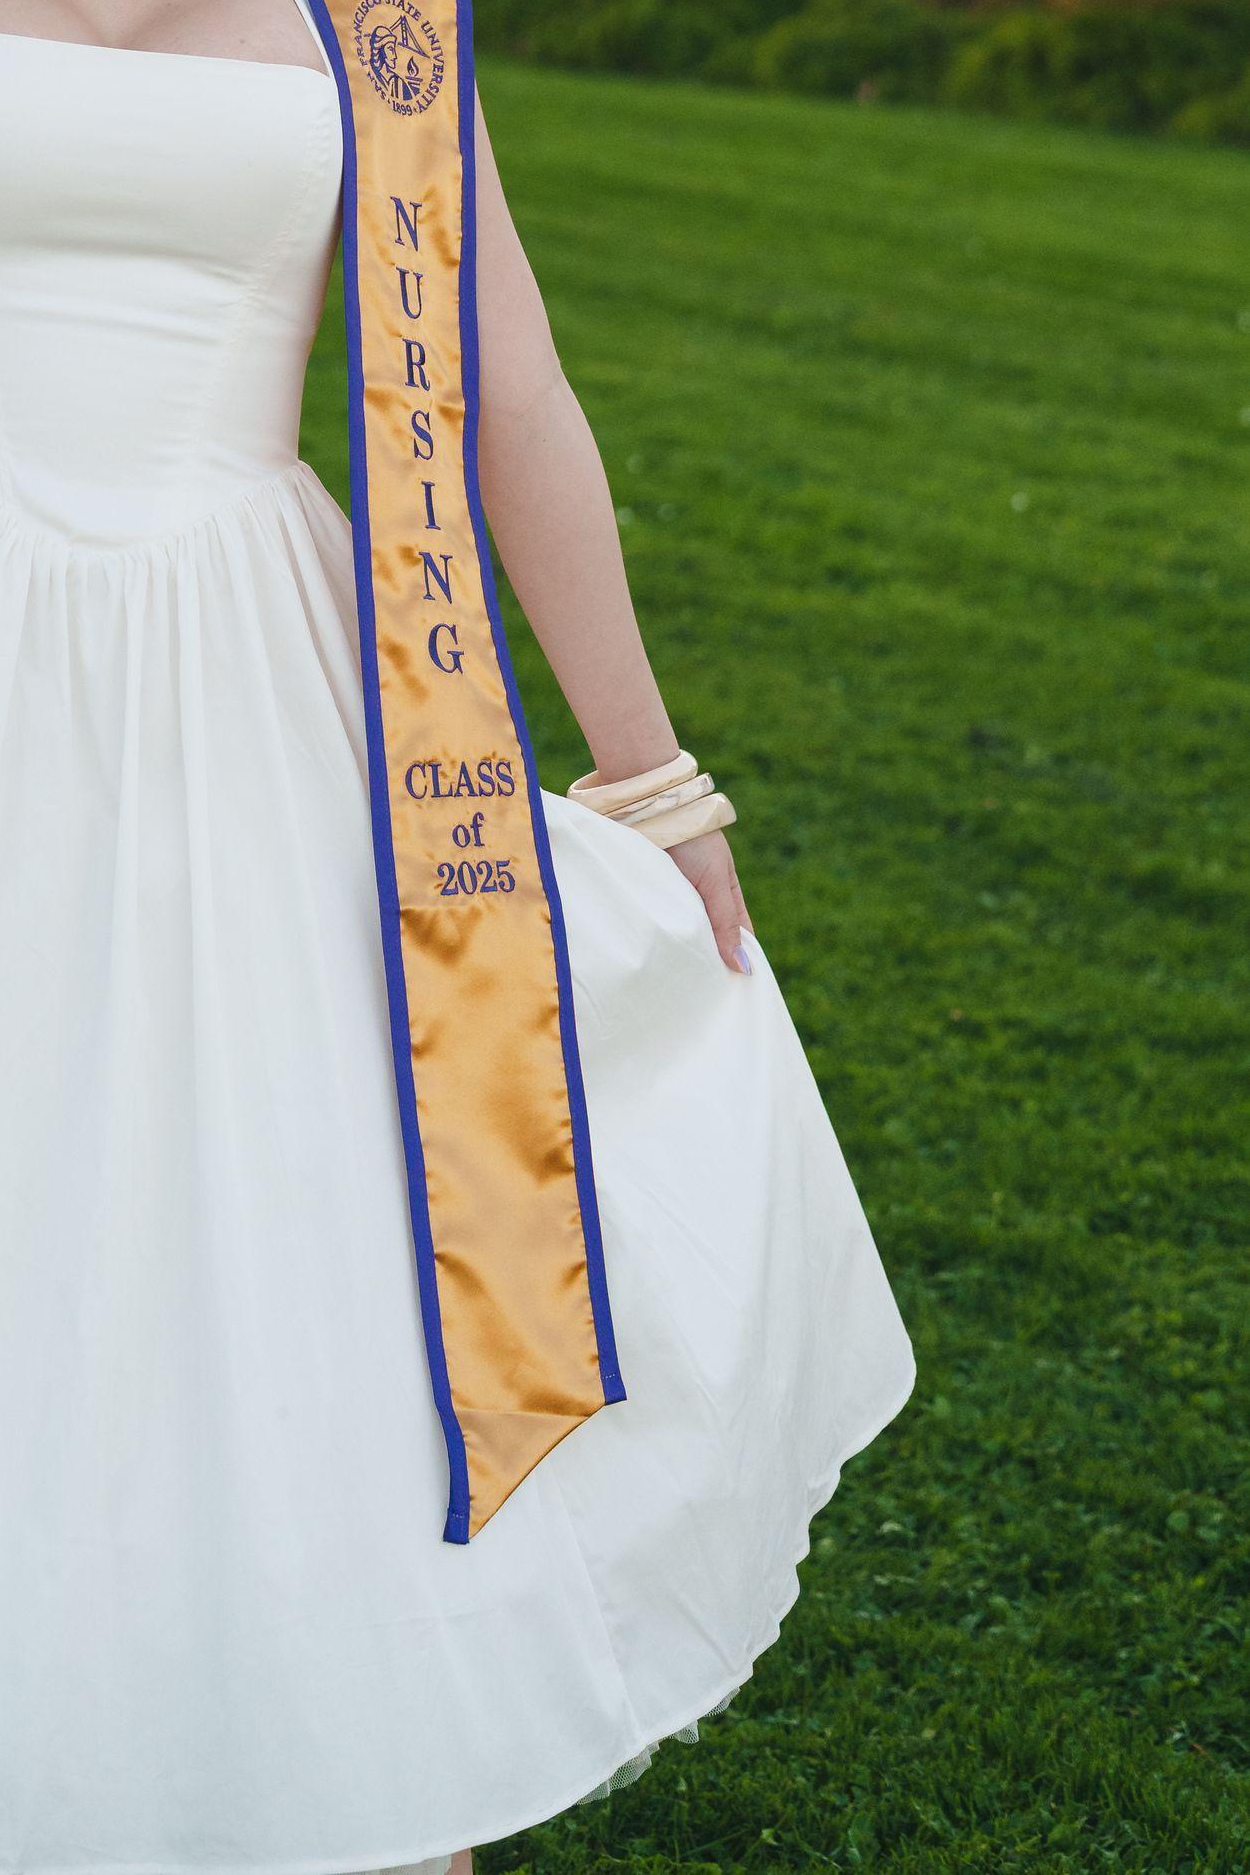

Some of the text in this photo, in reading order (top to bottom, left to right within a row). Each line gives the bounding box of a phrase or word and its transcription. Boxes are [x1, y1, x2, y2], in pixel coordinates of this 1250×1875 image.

[415, 20, 445, 114] UNIVERSITY
[391, 100, 413, 117] 1899
[389, 196, 464, 675] NURSING
[404, 760, 516, 800] CLASS
[452, 811, 486, 848] of
[436, 859, 516, 896] 2025
